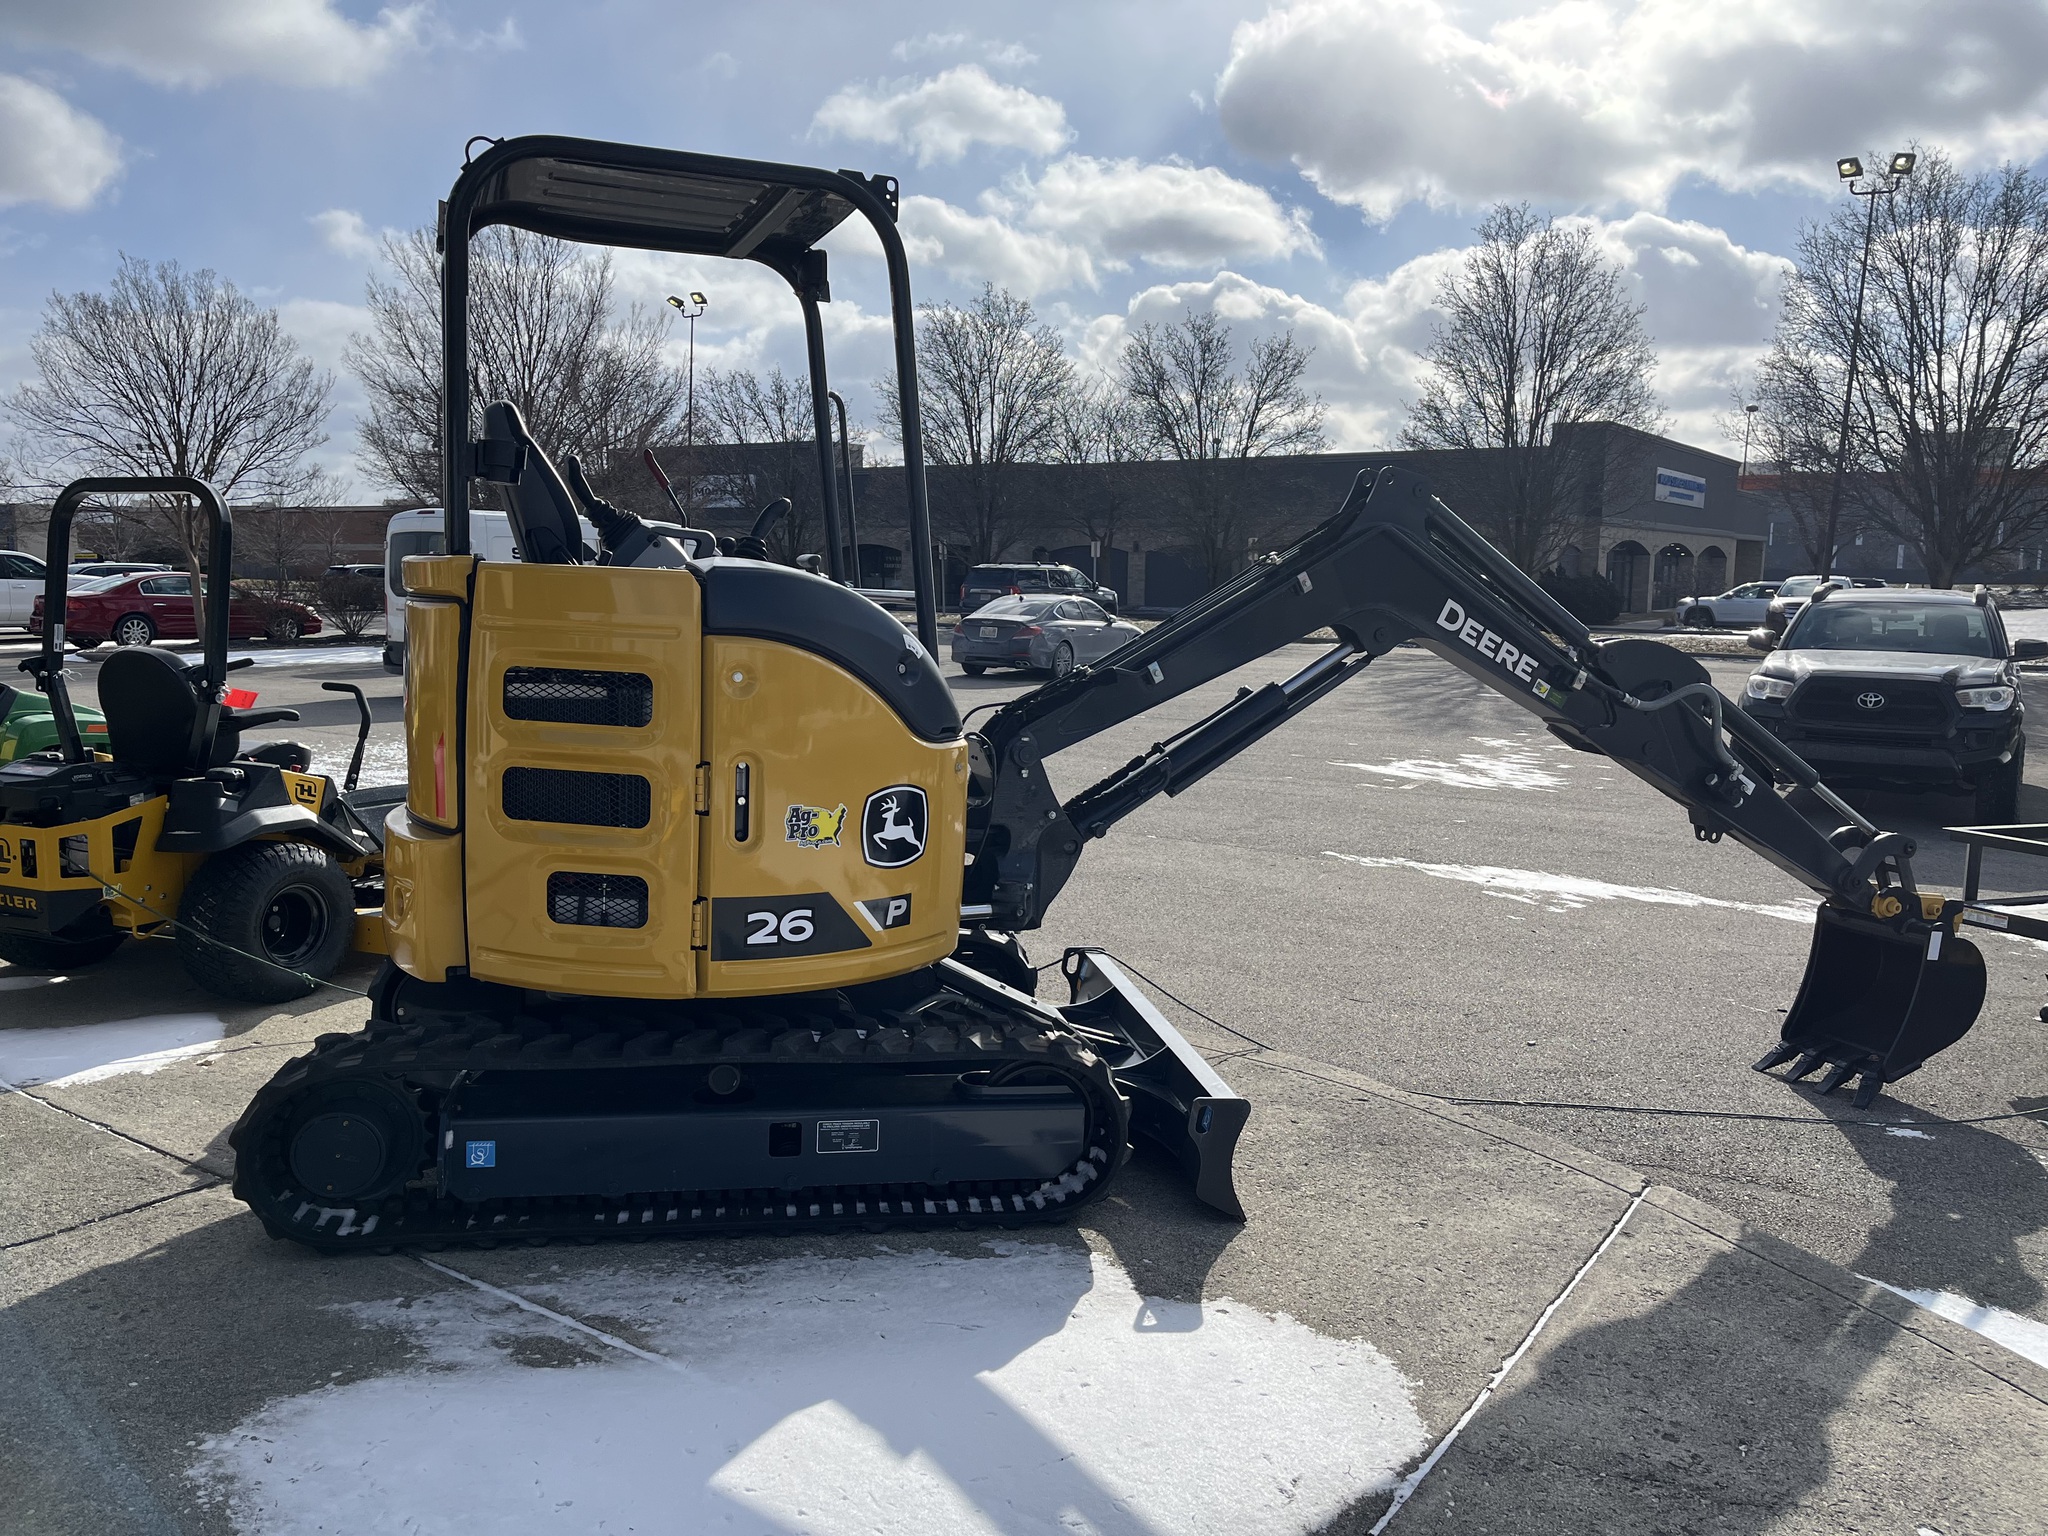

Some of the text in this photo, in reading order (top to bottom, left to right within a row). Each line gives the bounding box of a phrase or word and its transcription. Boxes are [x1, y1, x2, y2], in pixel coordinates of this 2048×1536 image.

[1436, 598, 1540, 683] DEERE
[788, 807, 819, 825] Ag-
[788, 824, 819, 839] Pro
[885, 898, 908, 926] P
[746, 909, 814, 945] 26
